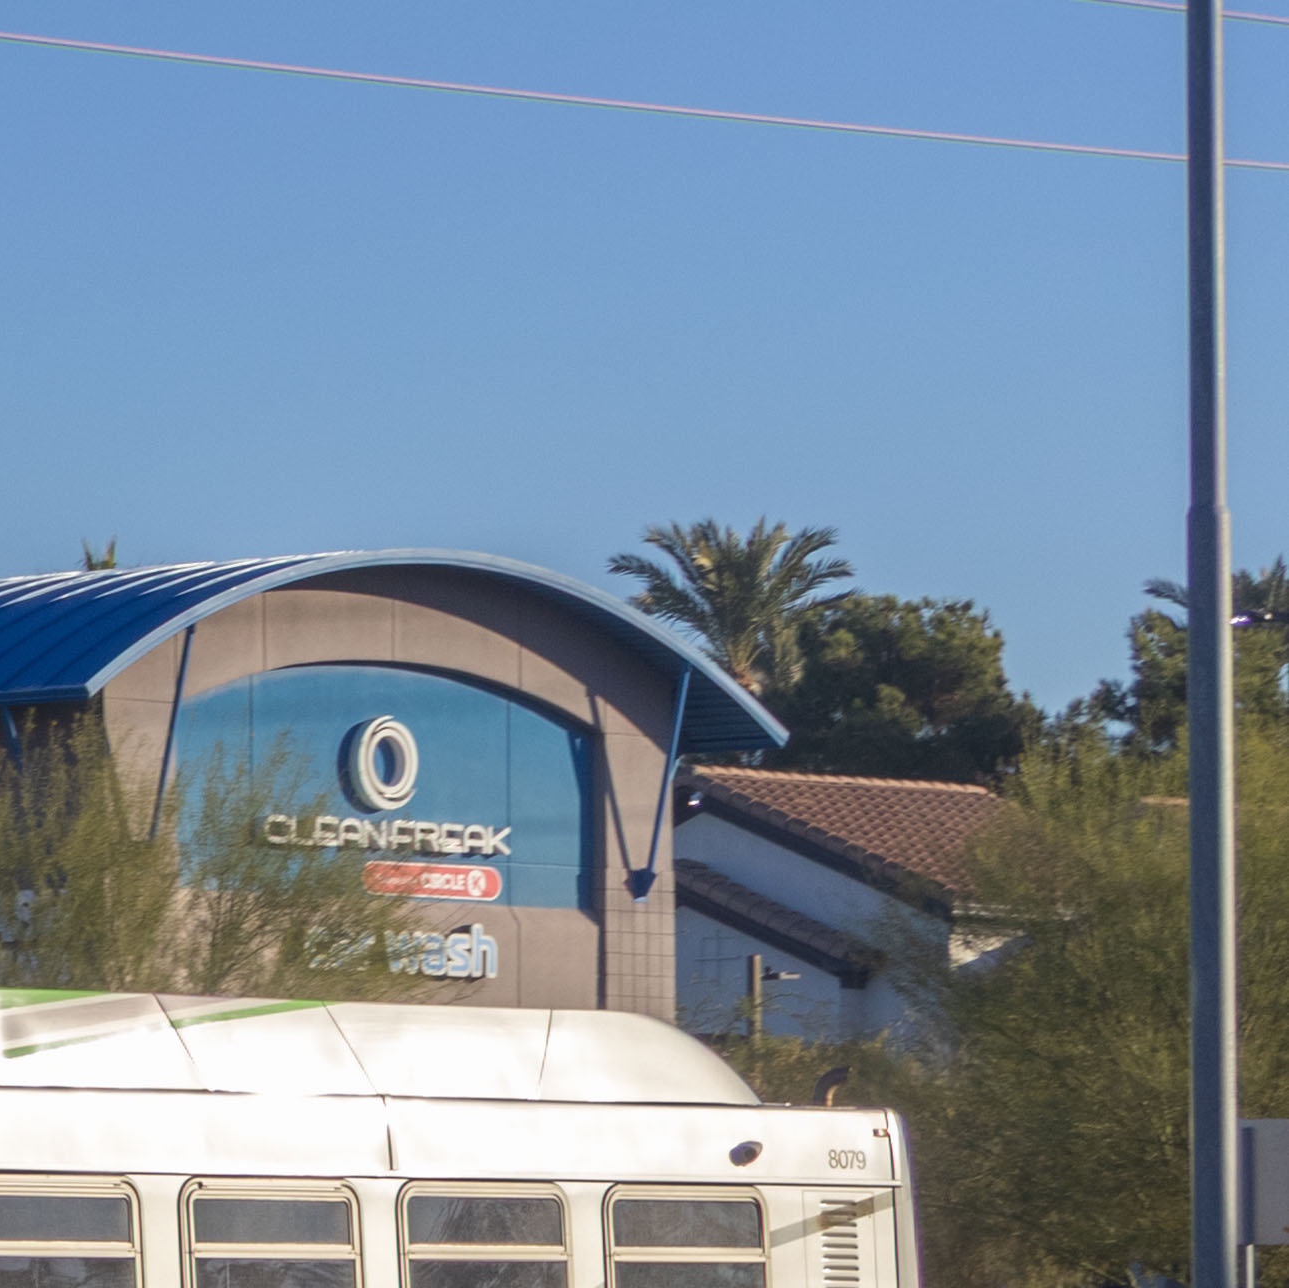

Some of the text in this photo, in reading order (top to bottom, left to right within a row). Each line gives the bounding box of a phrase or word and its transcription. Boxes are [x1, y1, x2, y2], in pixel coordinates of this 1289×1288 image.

[263, 814, 511, 856] CLEANFREAK
[420, 872, 466, 891] CIRCLE
[828, 1149, 867, 1170] 8079
